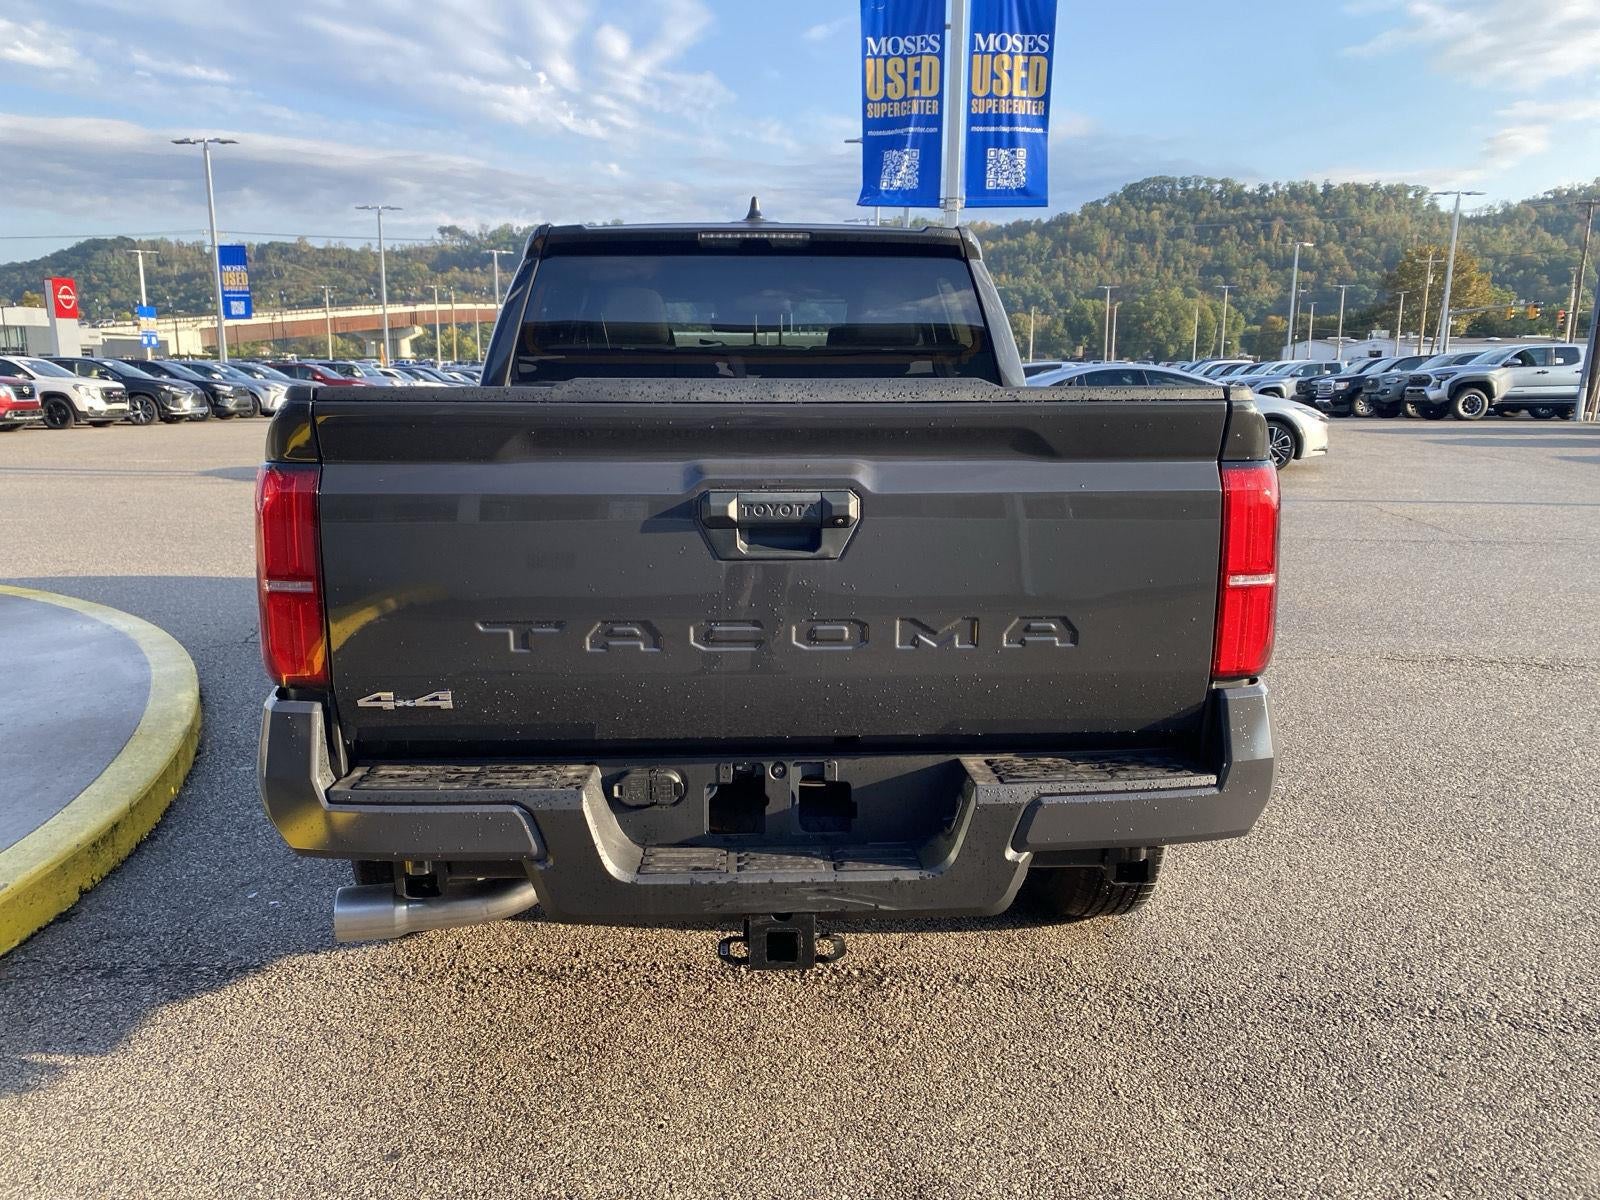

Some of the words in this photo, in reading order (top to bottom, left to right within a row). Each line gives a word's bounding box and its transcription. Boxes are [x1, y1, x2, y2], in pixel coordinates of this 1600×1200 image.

[866, 34, 940, 55] MOSES
[974, 33, 1050, 53] MOSES
[866, 55, 939, 100] USED
[972, 54, 1047, 97] USED
[867, 100, 938, 117] SUPERCENTER
[971, 99, 1044, 114] SUPERCENTER
[223, 272, 249, 286] USED
[741, 503, 818, 518] TOYOTA
[476, 616, 1078, 652] TACOMA
[357, 691, 453, 710] 4x4
